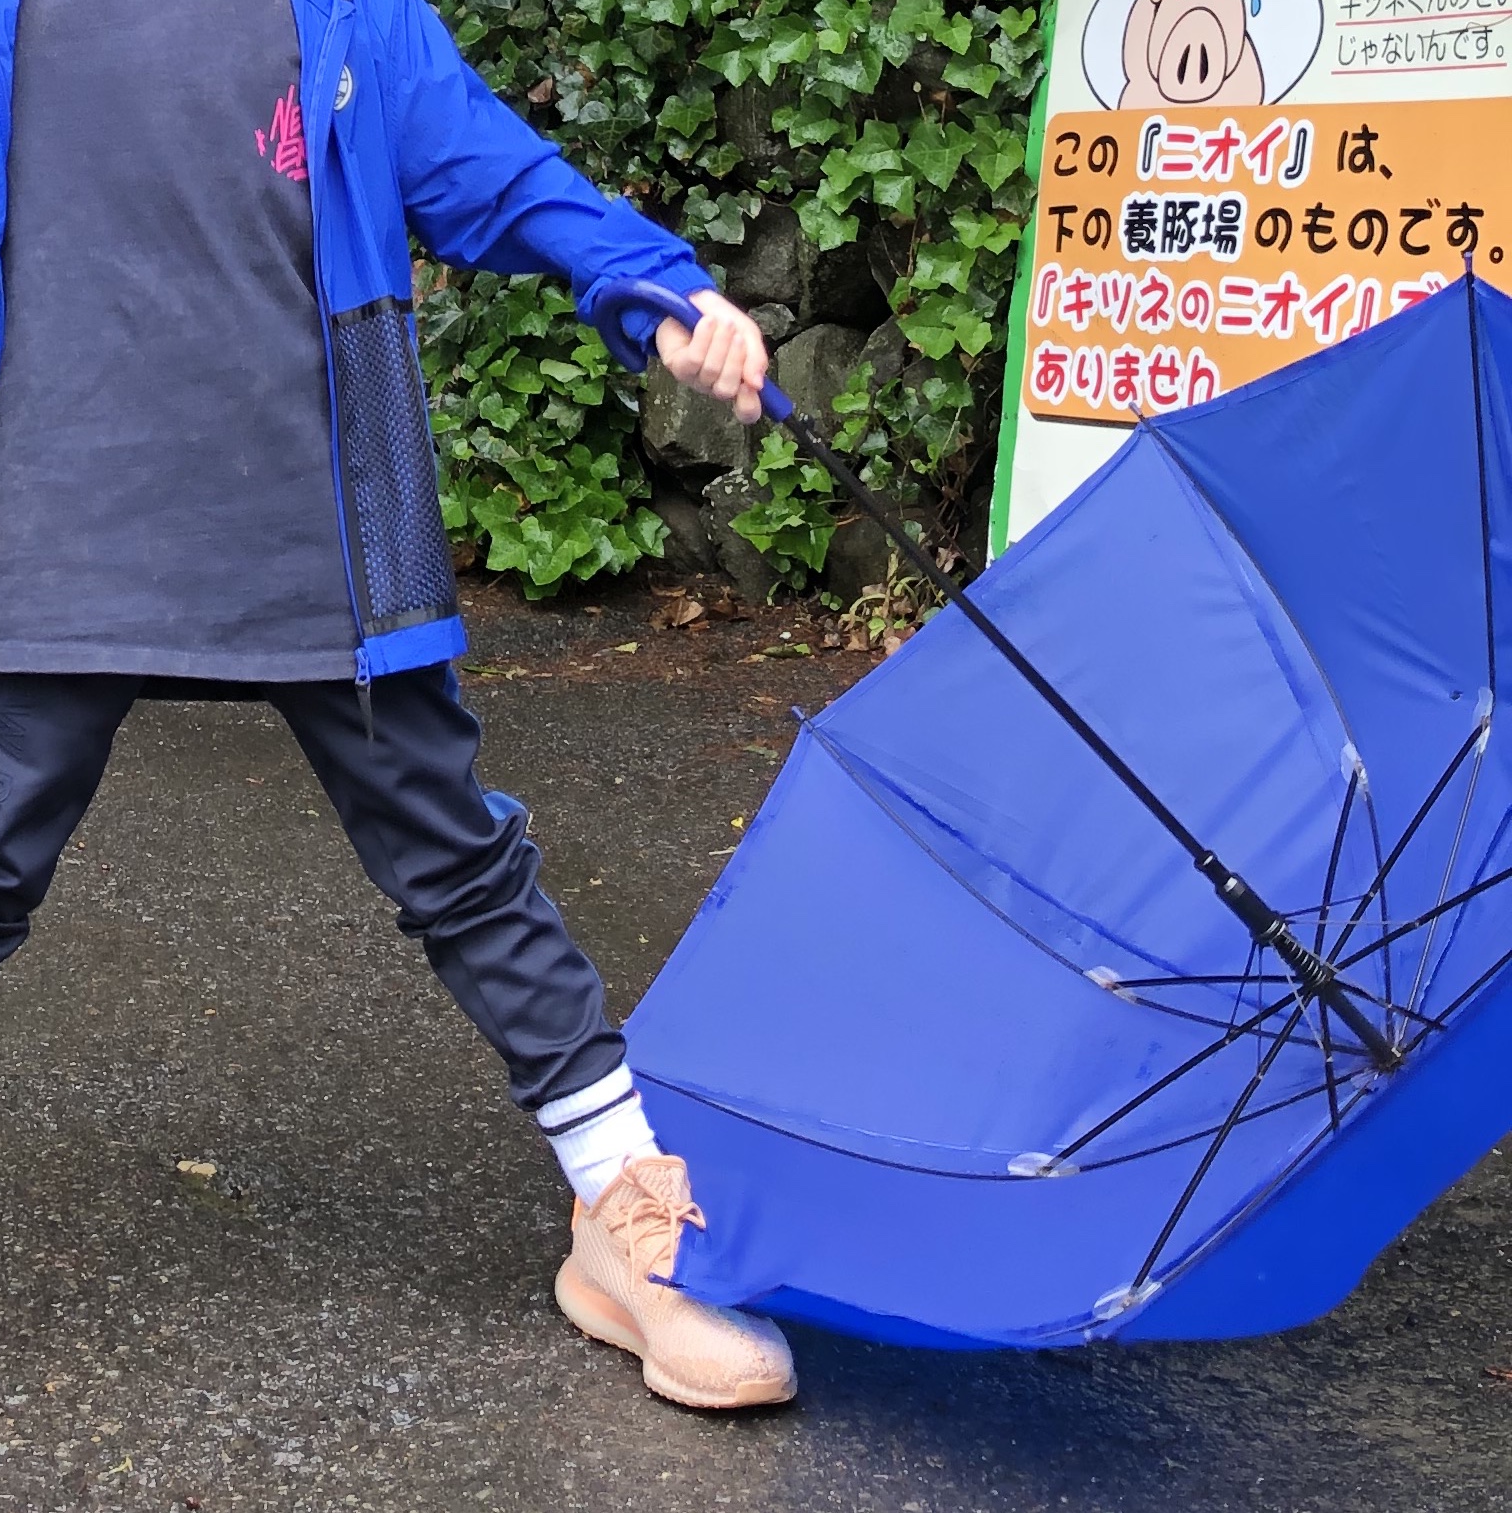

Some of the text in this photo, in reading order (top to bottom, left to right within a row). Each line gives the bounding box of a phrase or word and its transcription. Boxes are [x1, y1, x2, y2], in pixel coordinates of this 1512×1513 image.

[1337, 26, 1505, 66] じゃないんです。
